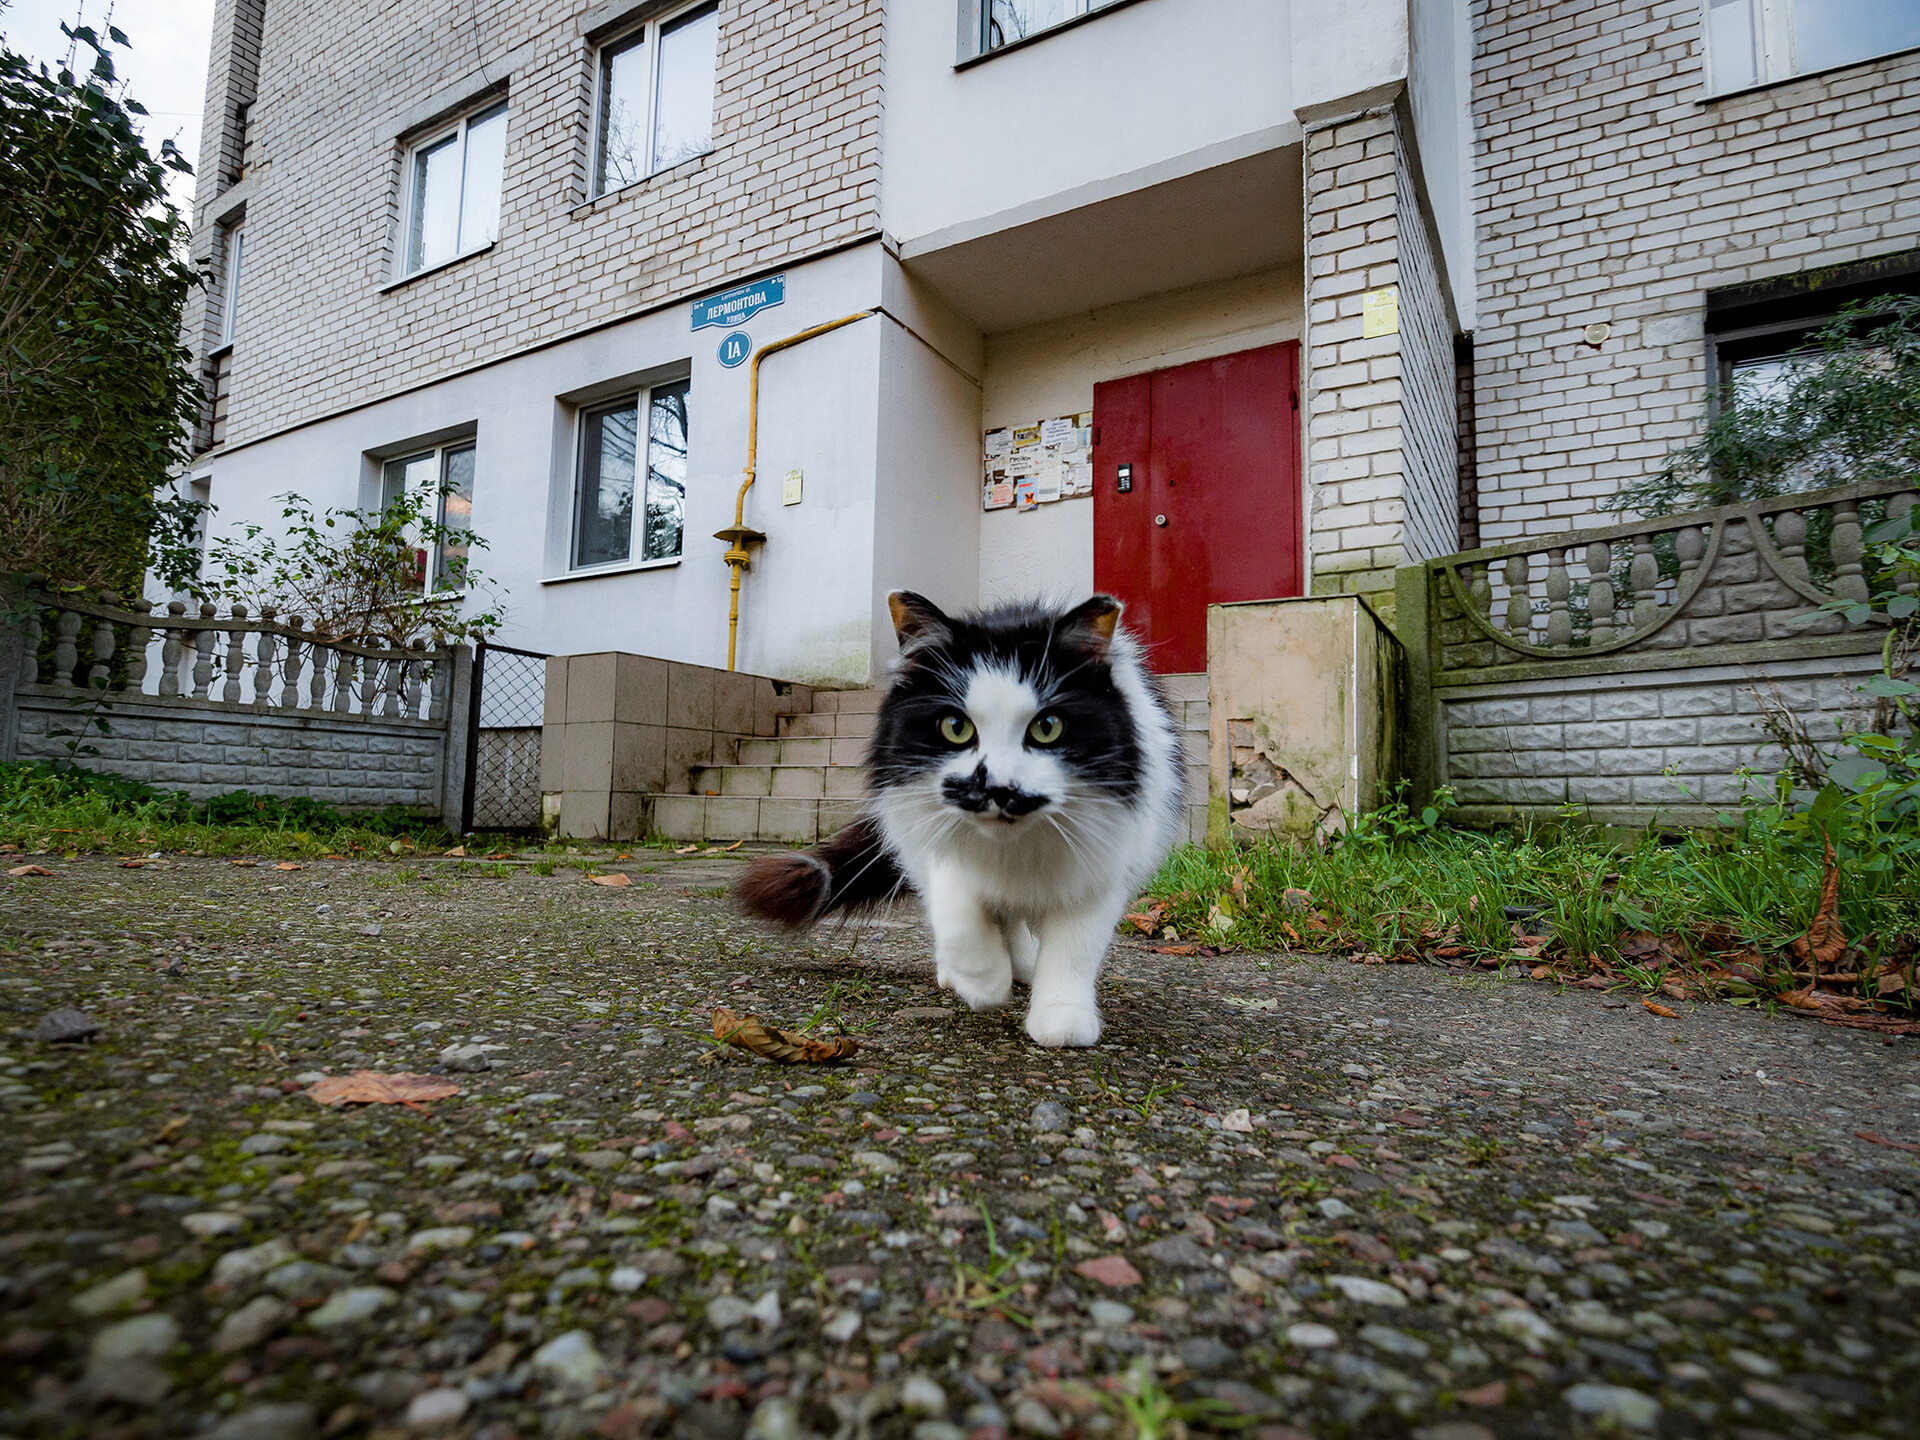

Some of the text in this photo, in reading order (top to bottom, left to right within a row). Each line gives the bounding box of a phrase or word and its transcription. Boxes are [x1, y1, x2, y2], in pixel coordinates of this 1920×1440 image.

[706, 291, 767, 320] ЛЕРМОНТОВА
[726, 312, 746, 324] УЛИЦА
[727, 341, 741, 360] 1А
